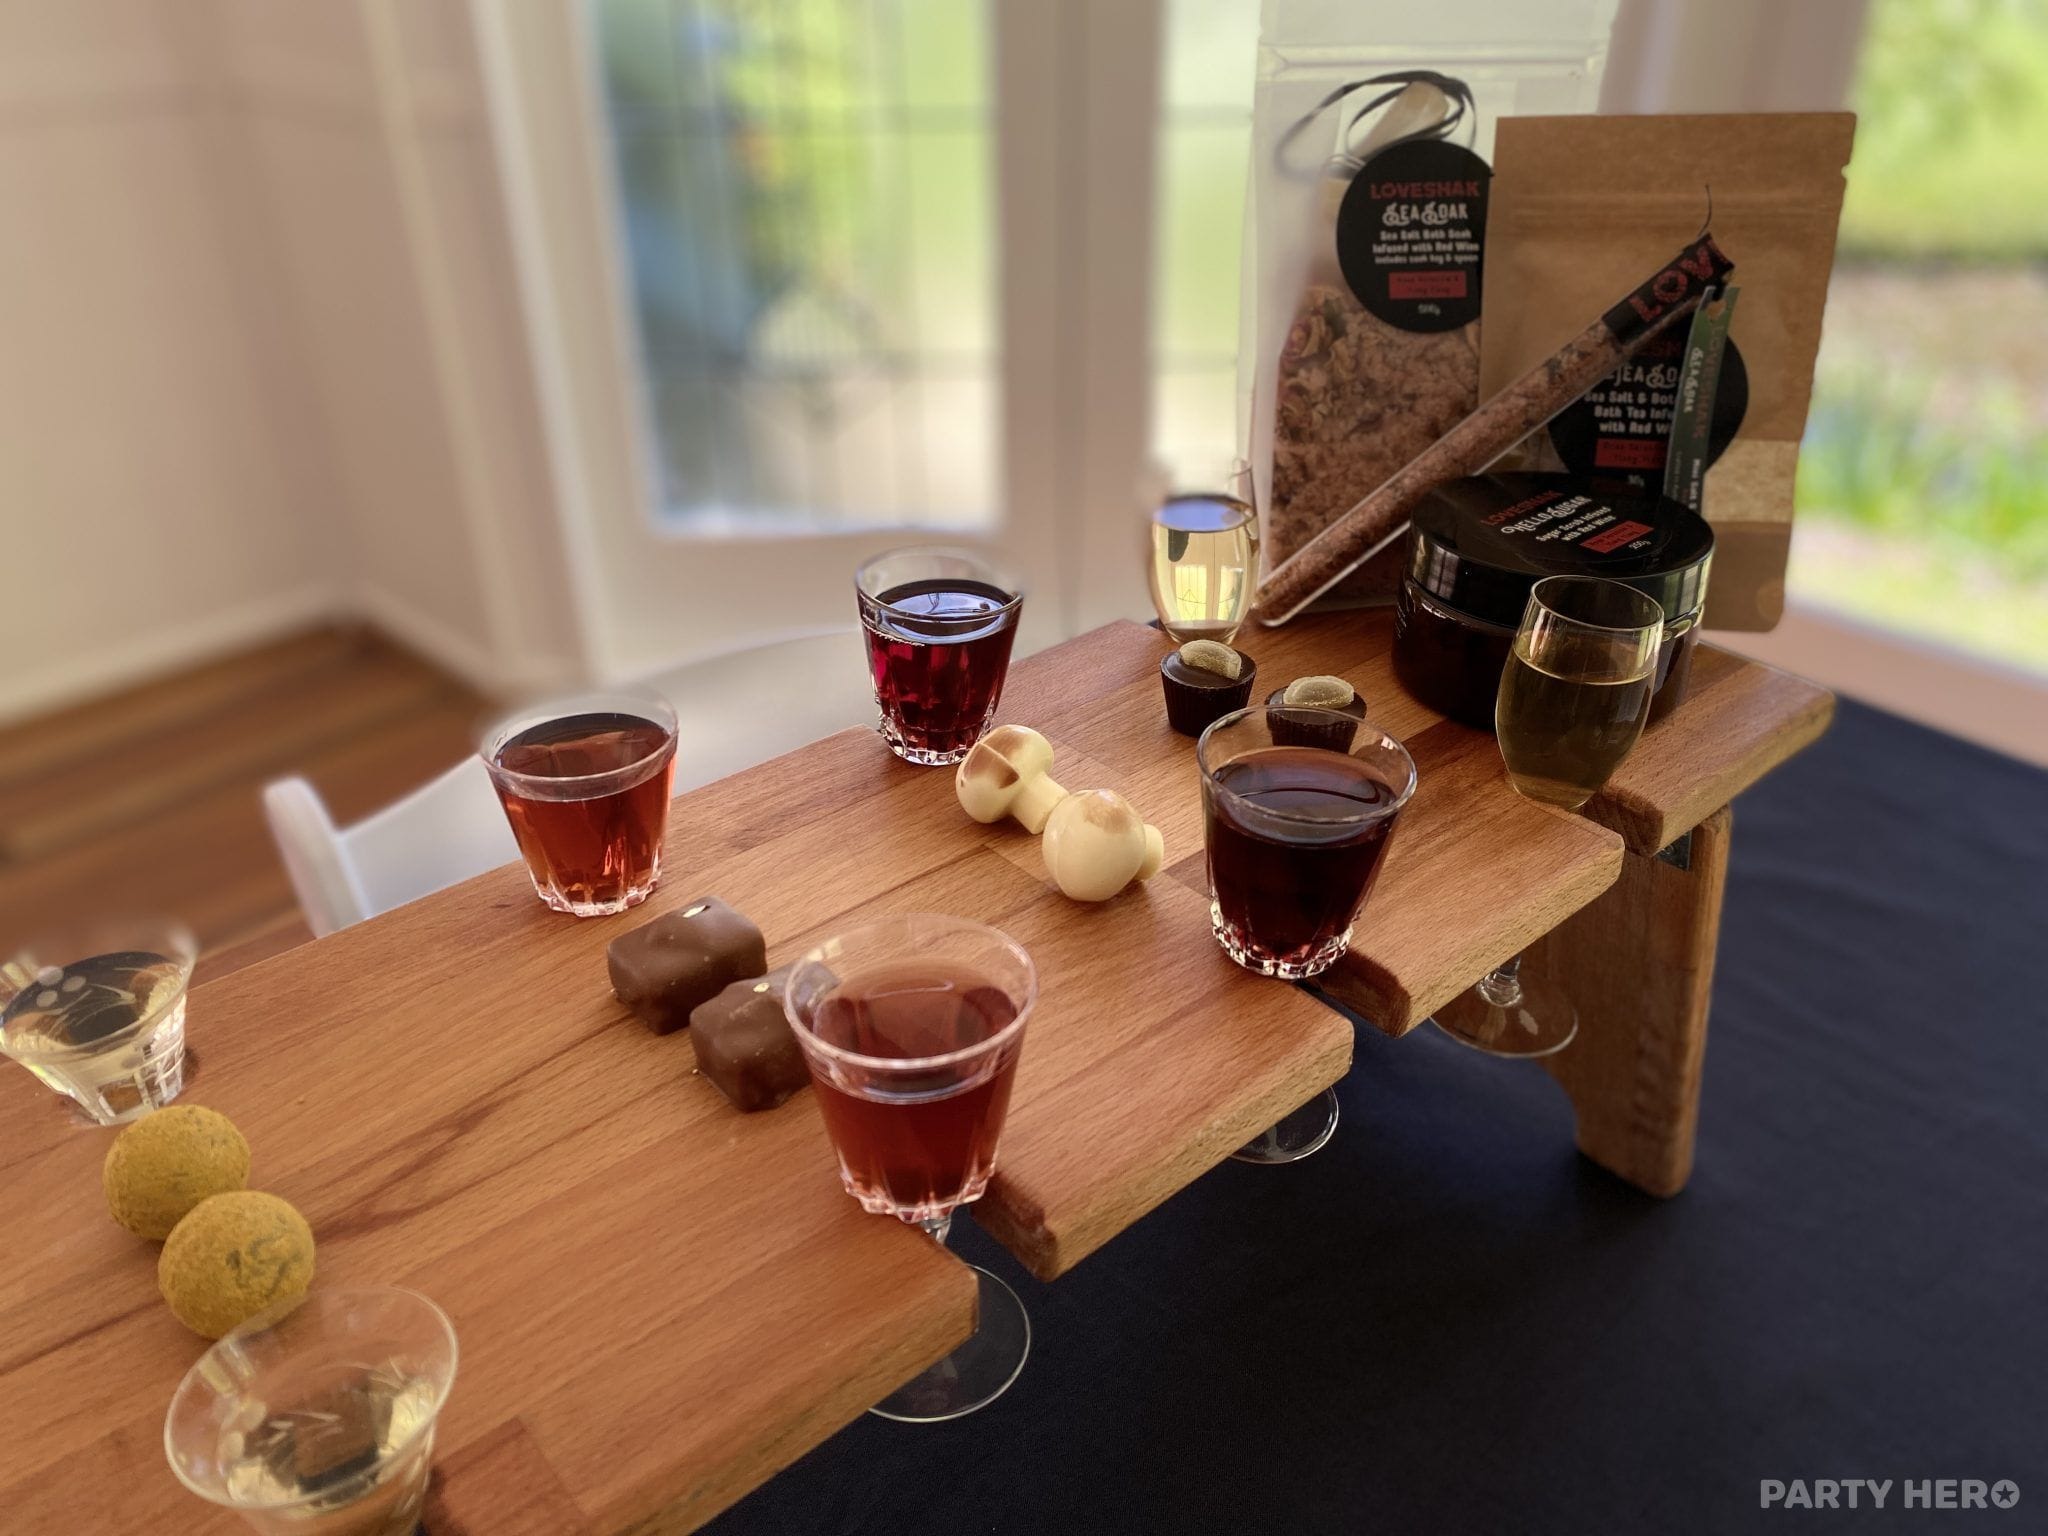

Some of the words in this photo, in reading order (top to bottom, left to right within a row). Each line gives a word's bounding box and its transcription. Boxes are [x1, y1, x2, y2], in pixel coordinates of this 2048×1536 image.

[1370, 180, 1480, 200] LOVESHAK
[1411, 242, 1433, 253] with
[1435, 241, 1453, 252] Red
[1609, 390, 1634, 403] Salt
[1594, 404, 1622, 418] Bath
[1627, 405, 1647, 419] Tea
[1599, 420, 1626, 433] with
[1629, 420, 1652, 434] Red
